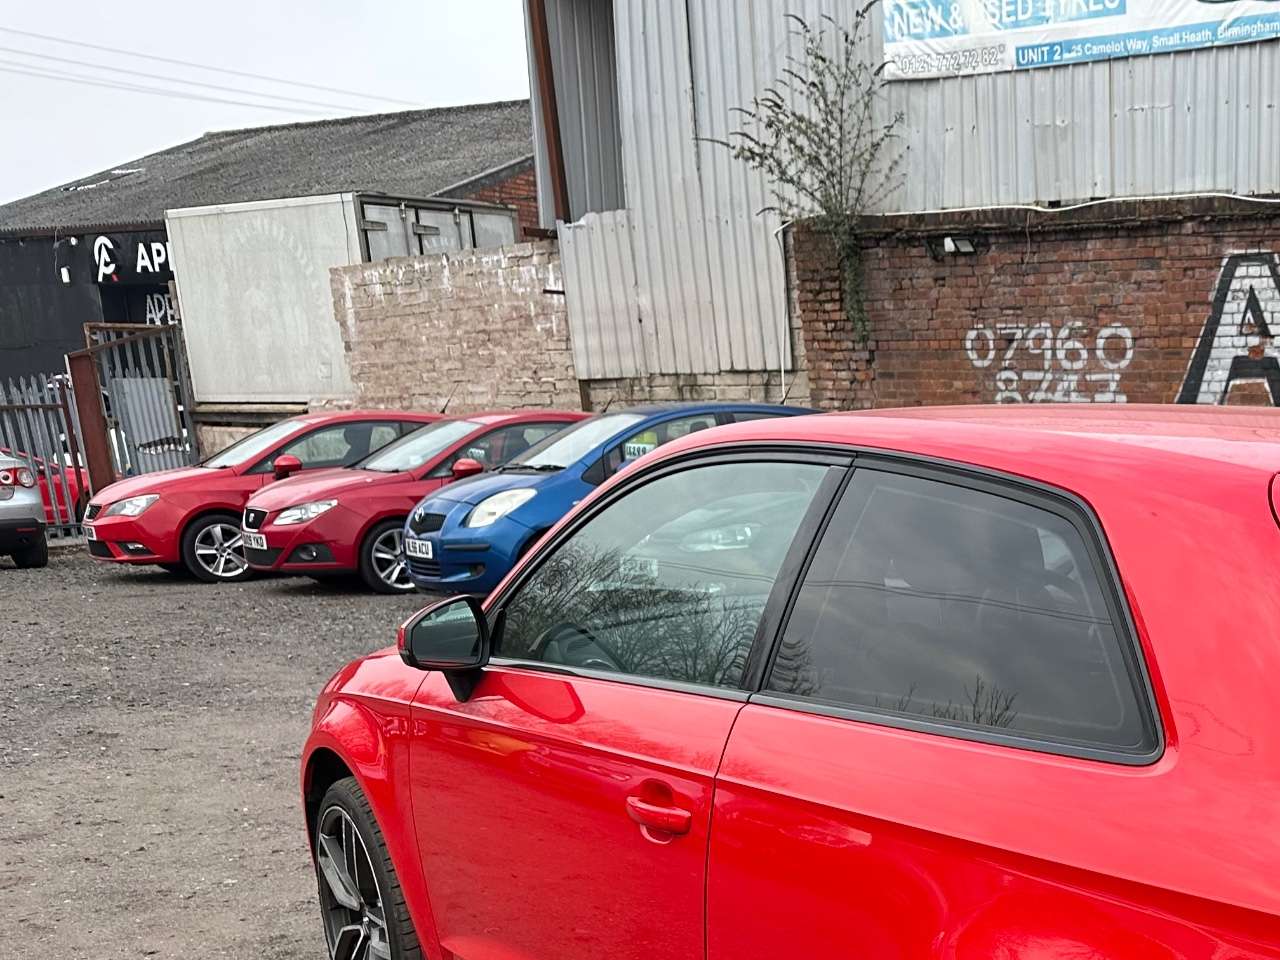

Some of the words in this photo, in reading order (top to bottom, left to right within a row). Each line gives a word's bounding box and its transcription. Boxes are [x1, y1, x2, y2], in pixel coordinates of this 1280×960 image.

[1018, 46, 1050, 64] UNIT
[1053, 45, 1062, 61] 2
[1084, 40, 1124, 56] Camelot
[1126, 37, 1150, 53] Way,
[1152, 33, 1180, 48] Small
[1217, 20, 1280, 40] Birmingham
